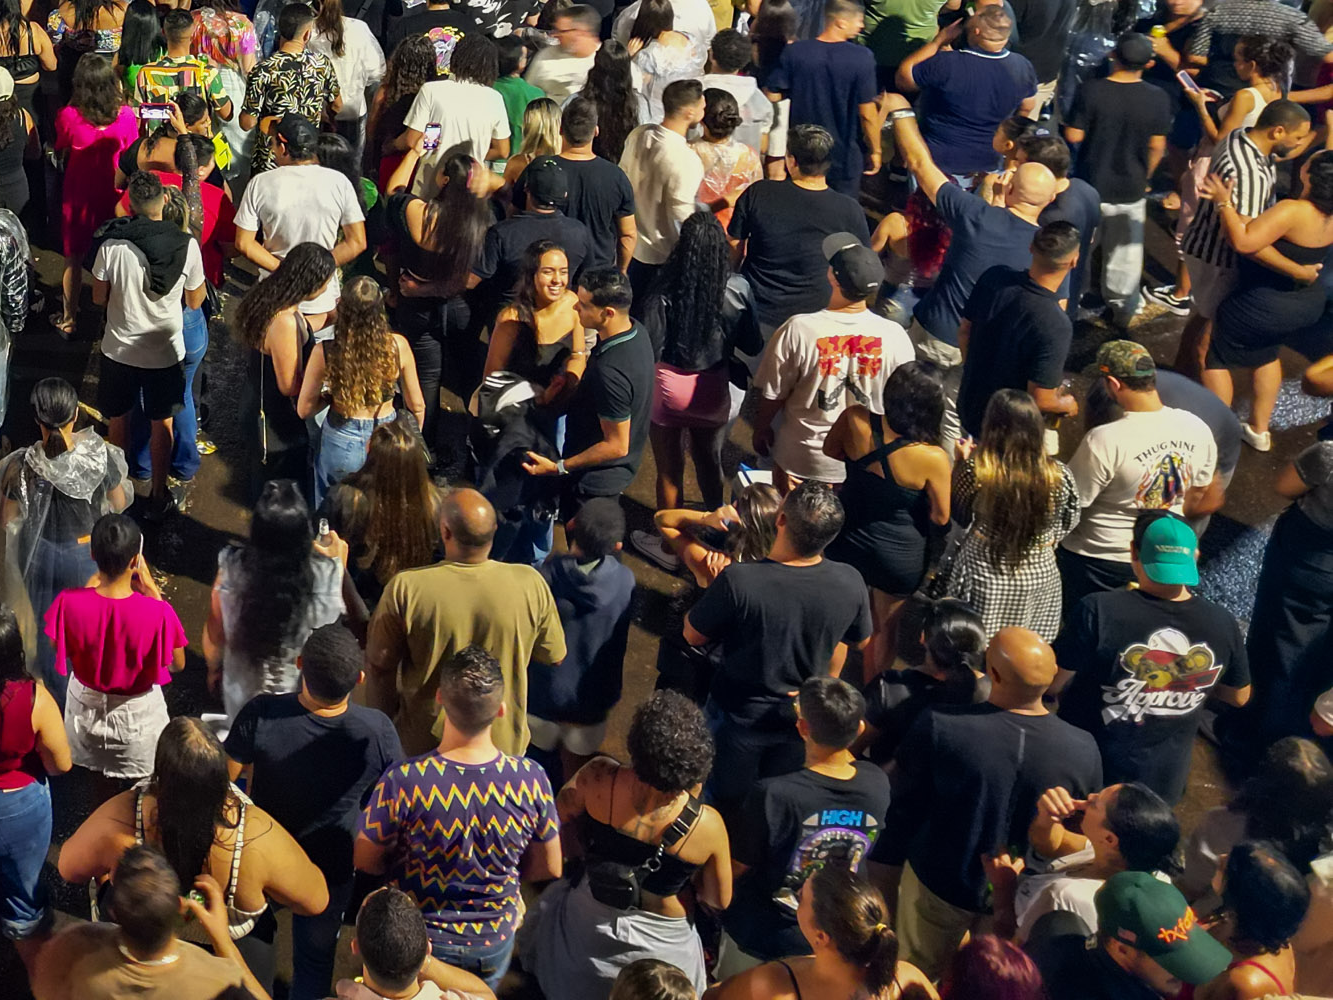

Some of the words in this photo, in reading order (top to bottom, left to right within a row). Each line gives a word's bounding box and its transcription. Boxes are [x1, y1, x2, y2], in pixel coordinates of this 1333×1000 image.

[1134, 443, 1168, 464] THUG
[1170, 440, 1197, 453] NINE
[1104, 678, 1207, 722] Approve
[820, 809, 864, 827] HIGH
